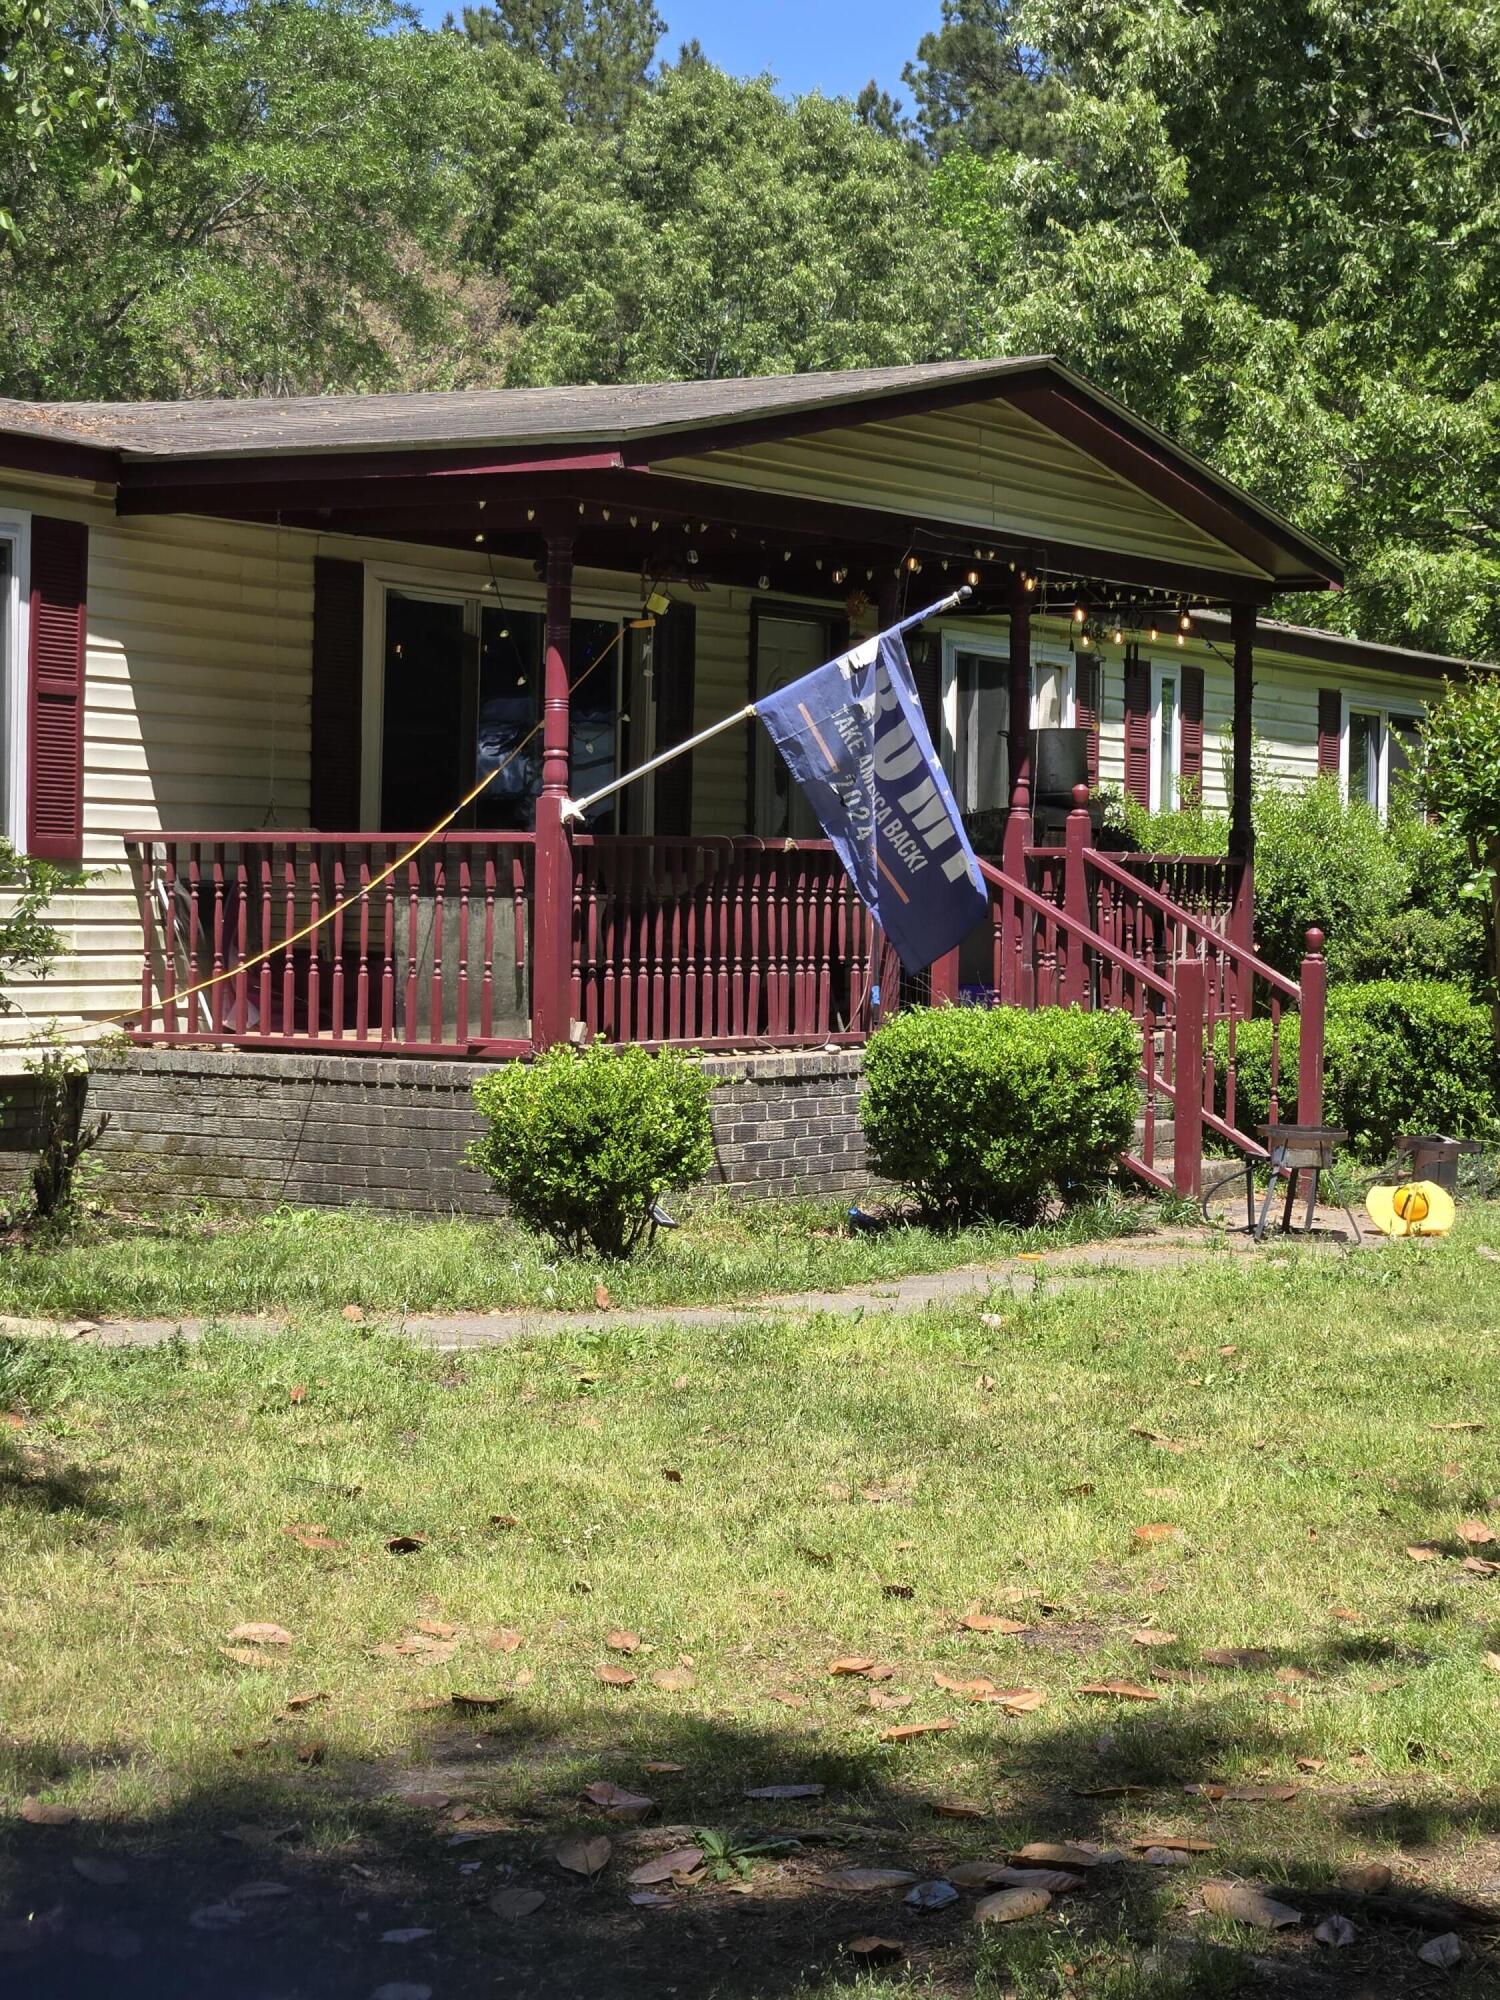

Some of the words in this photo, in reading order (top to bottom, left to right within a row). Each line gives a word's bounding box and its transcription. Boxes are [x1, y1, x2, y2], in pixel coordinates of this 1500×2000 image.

[829, 774, 874, 841] 2024
[830, 703, 867, 755] TAKE
[882, 818, 929, 874] BACK!
